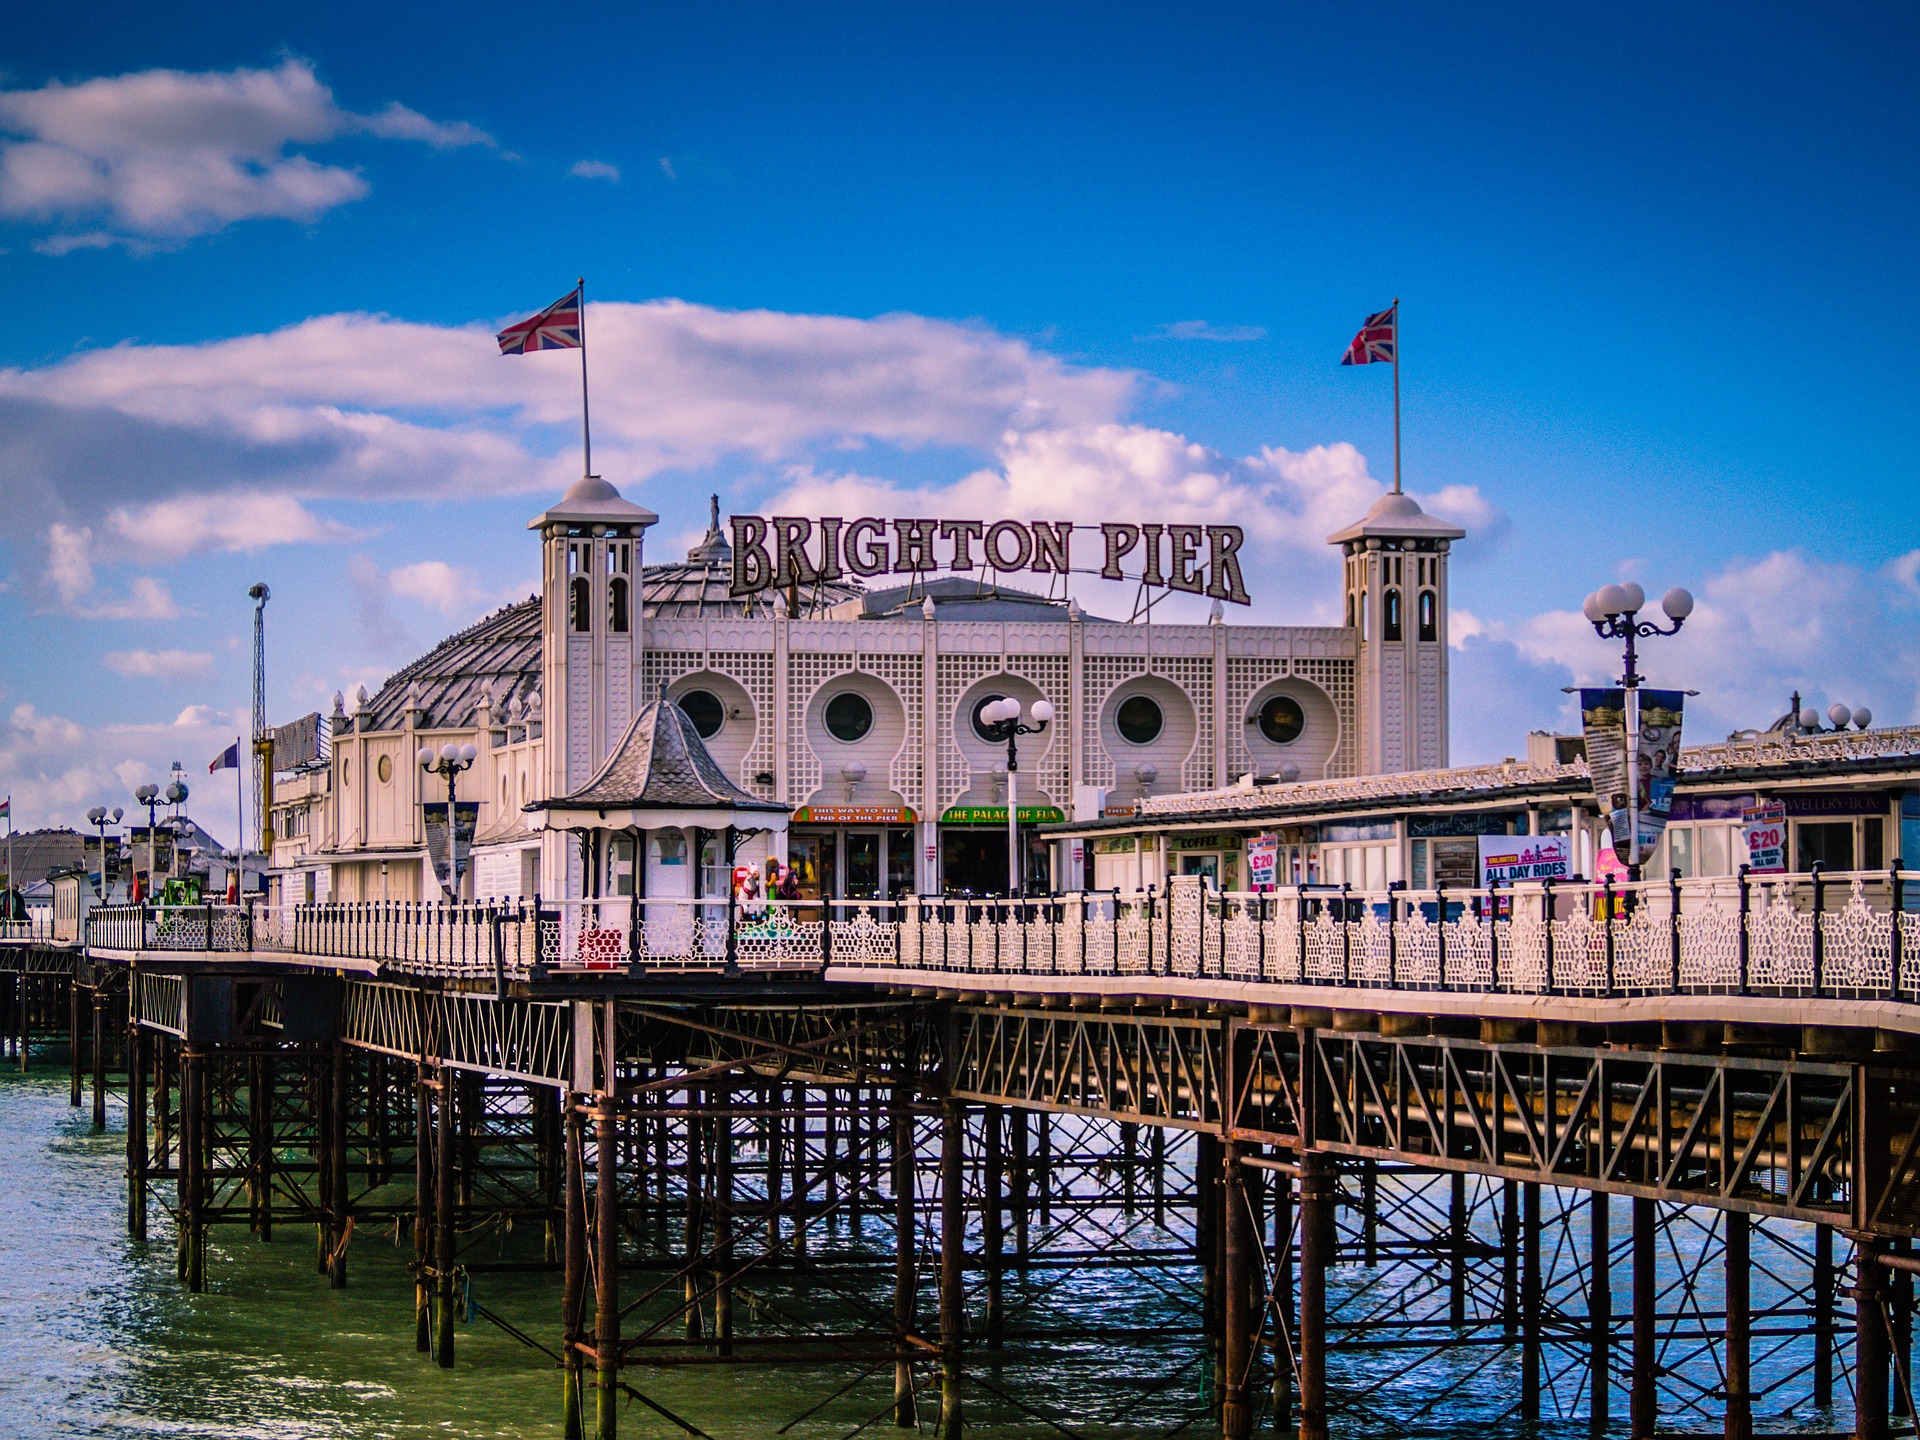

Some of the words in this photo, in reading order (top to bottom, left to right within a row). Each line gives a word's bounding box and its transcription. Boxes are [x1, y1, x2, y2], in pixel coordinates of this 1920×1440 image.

[729, 516, 1073, 597] BRIGHTON
[1100, 523, 1251, 606] PIER
[949, 810, 968, 820] THE
[1018, 810, 1031, 820] OF
[1036, 810, 1058, 819] FUN
[1181, 835, 1218, 849] COFFEE
[1749, 829, 1779, 850] £20
[1253, 854, 1272, 869] £20
[1486, 867, 1507, 881] ALL
[1509, 865, 1531, 879] DAY
[1534, 862, 1567, 877] RIDES
